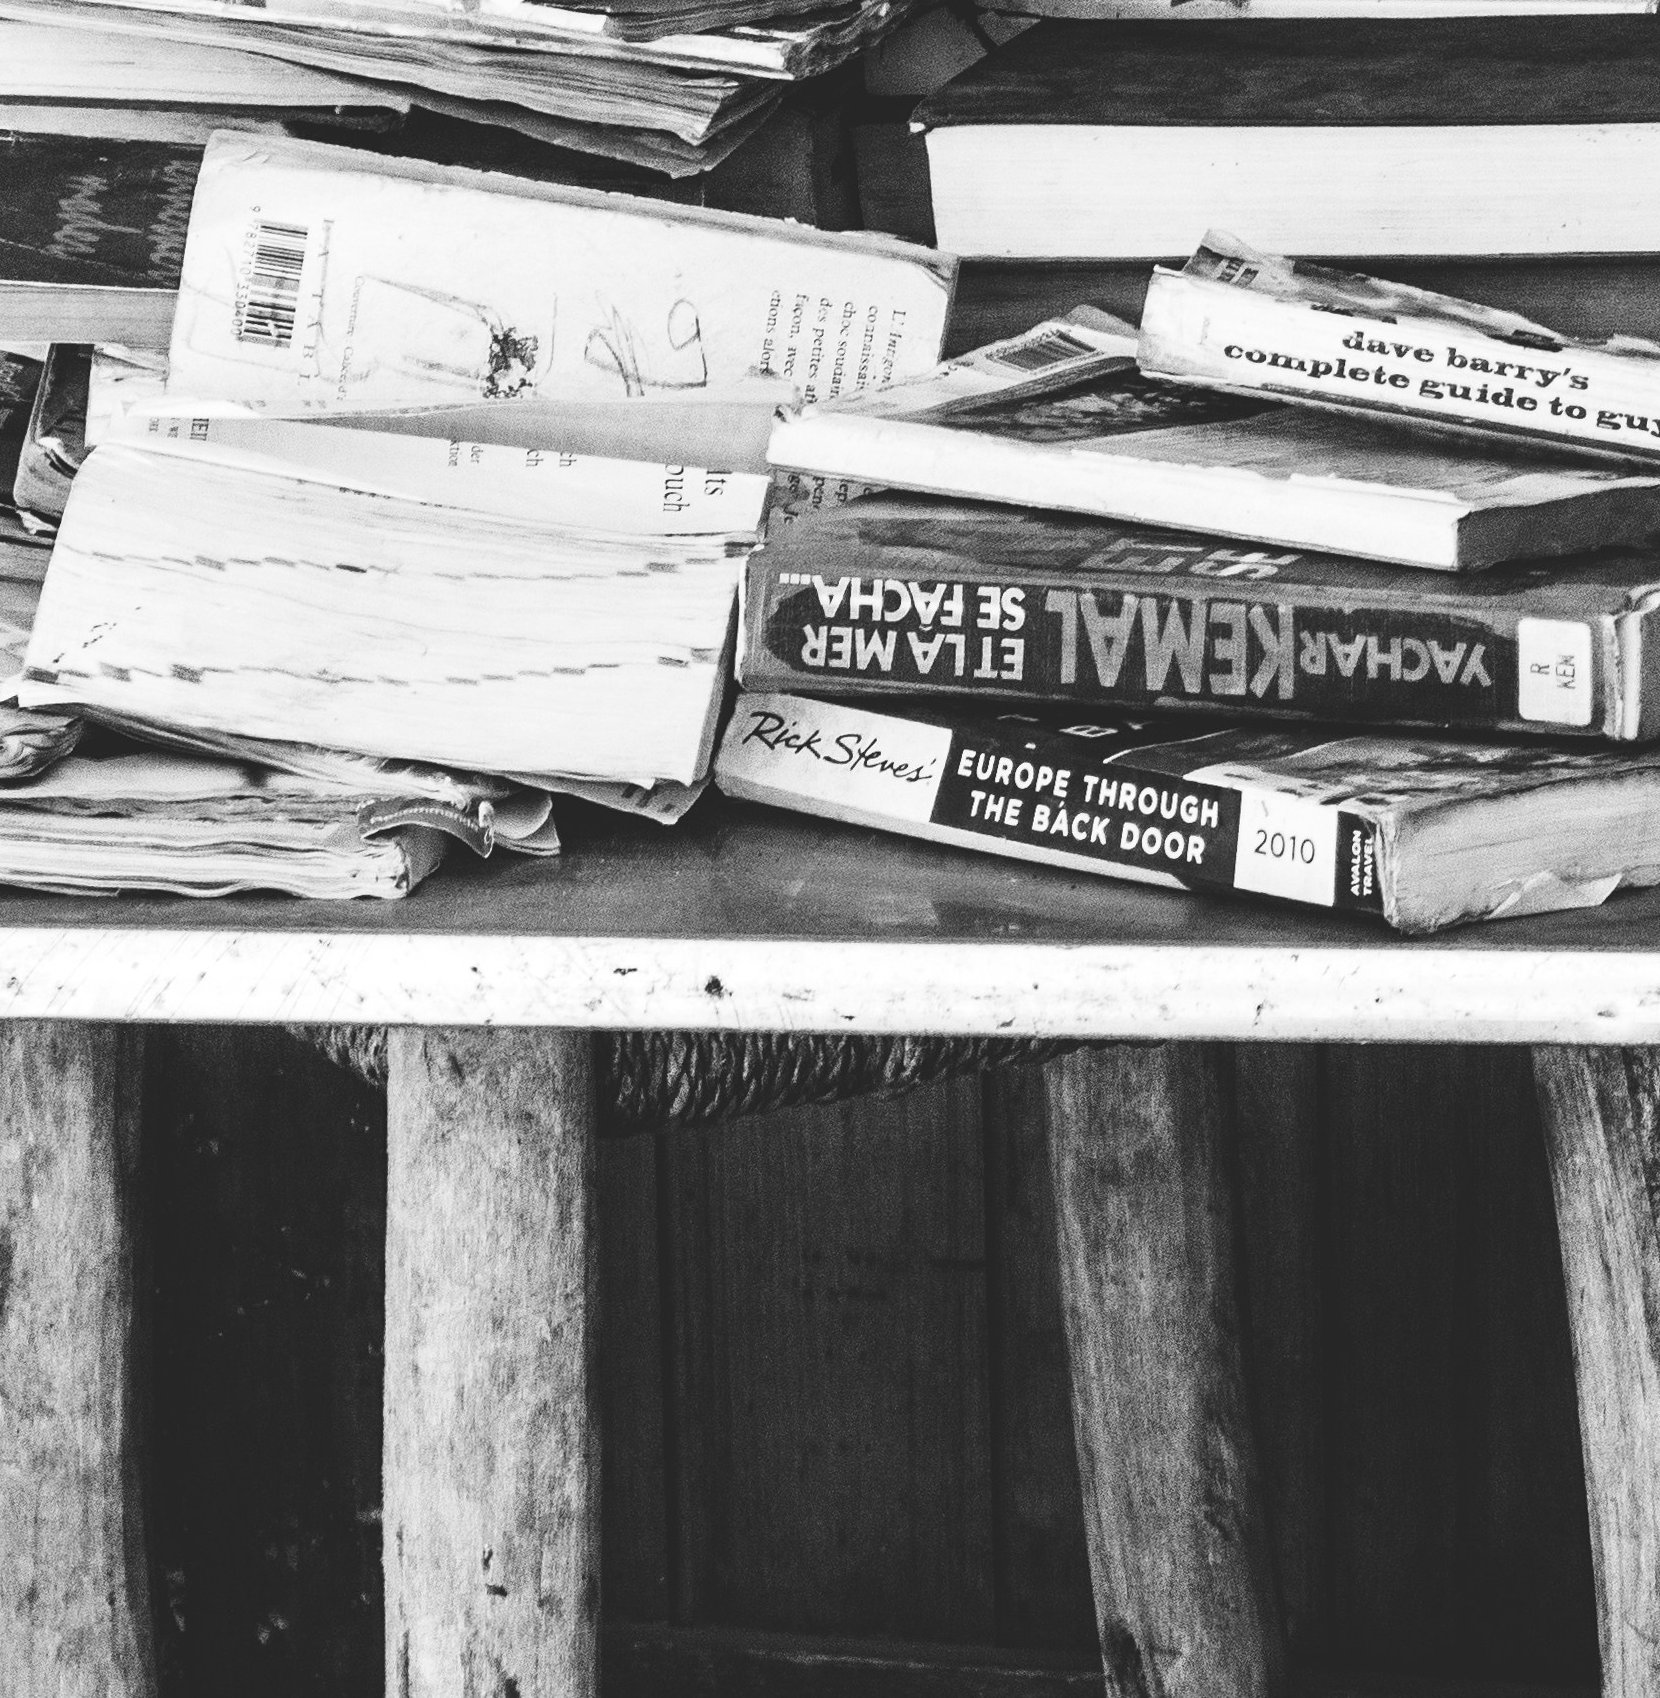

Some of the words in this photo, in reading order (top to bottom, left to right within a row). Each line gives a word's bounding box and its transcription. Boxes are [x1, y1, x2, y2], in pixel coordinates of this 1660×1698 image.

[1224, 343, 1411, 388] complete
[1419, 379, 1538, 412] guide
[1550, 397, 1587, 421] to
[1342, 330, 1435, 363] dave
[1447, 347, 1589, 389] barry's
[976, 586, 1026, 632] SE
[800, 623, 897, 672] MER
[906, 630, 966, 676] LA
[973, 636, 1025, 681] ET
[1044, 589, 1295, 701] KEMAL
[1299, 630, 1493, 688] YACHAR
[1529, 661, 1550, 677] R
[742, 710, 823, 760] Rick
[957, 748, 1071, 798] EUROPE
[1082, 774, 1219, 829] THROUGH
[970, 790, 1021, 827] THE
[1120, 822, 1206, 864] DOOR
[1254, 829, 1315, 864] 2010
[1350, 829, 1362, 897] AVALON
[1362, 836, 1374, 897] TRAVEL
